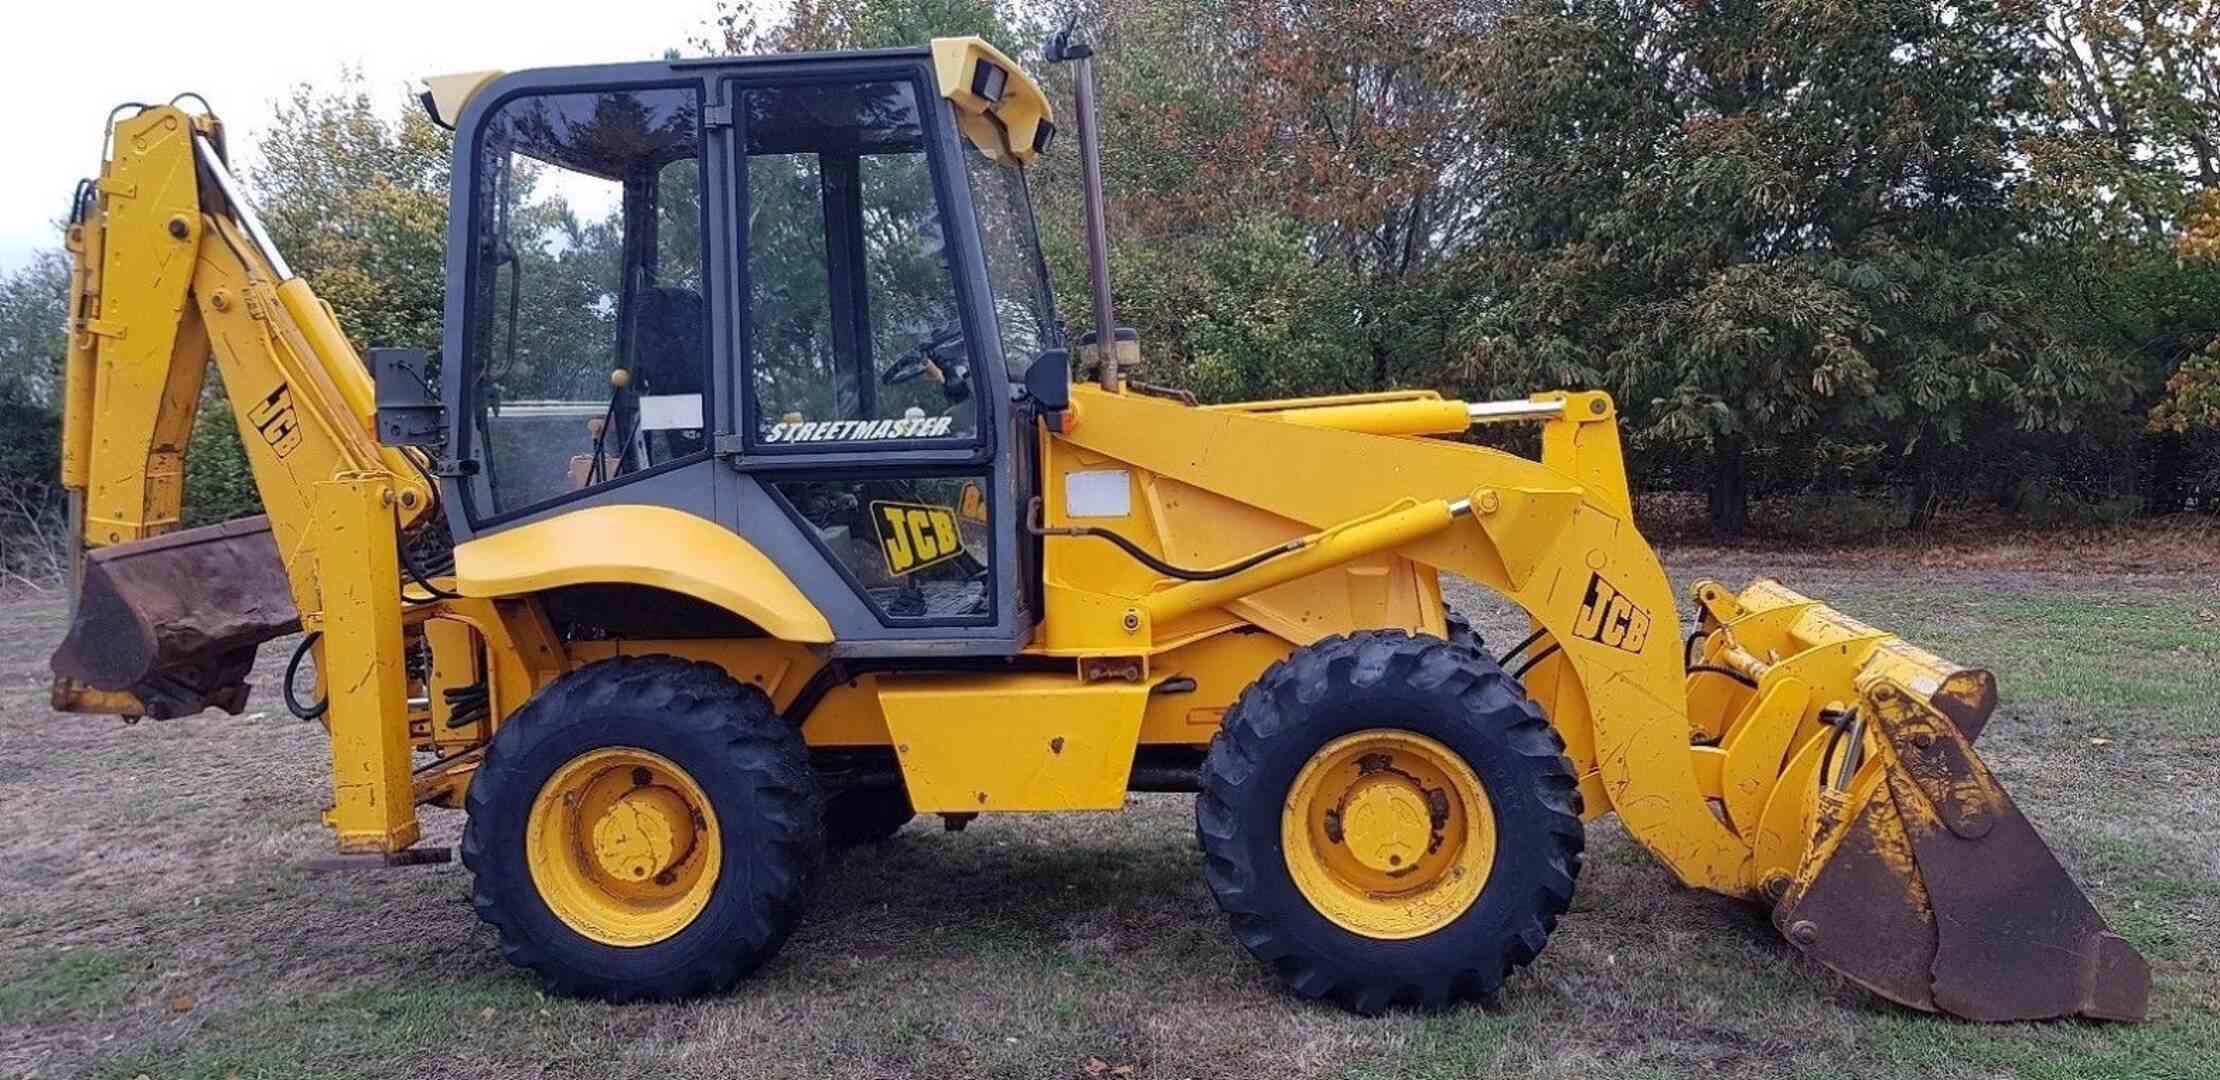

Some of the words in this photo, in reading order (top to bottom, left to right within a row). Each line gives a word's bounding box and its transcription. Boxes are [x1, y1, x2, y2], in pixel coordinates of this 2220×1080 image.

[247, 382, 303, 458] JCB
[765, 416, 952, 442] STREETMASTER
[883, 506, 957, 571] JCB
[1572, 571, 1651, 654] JCB
